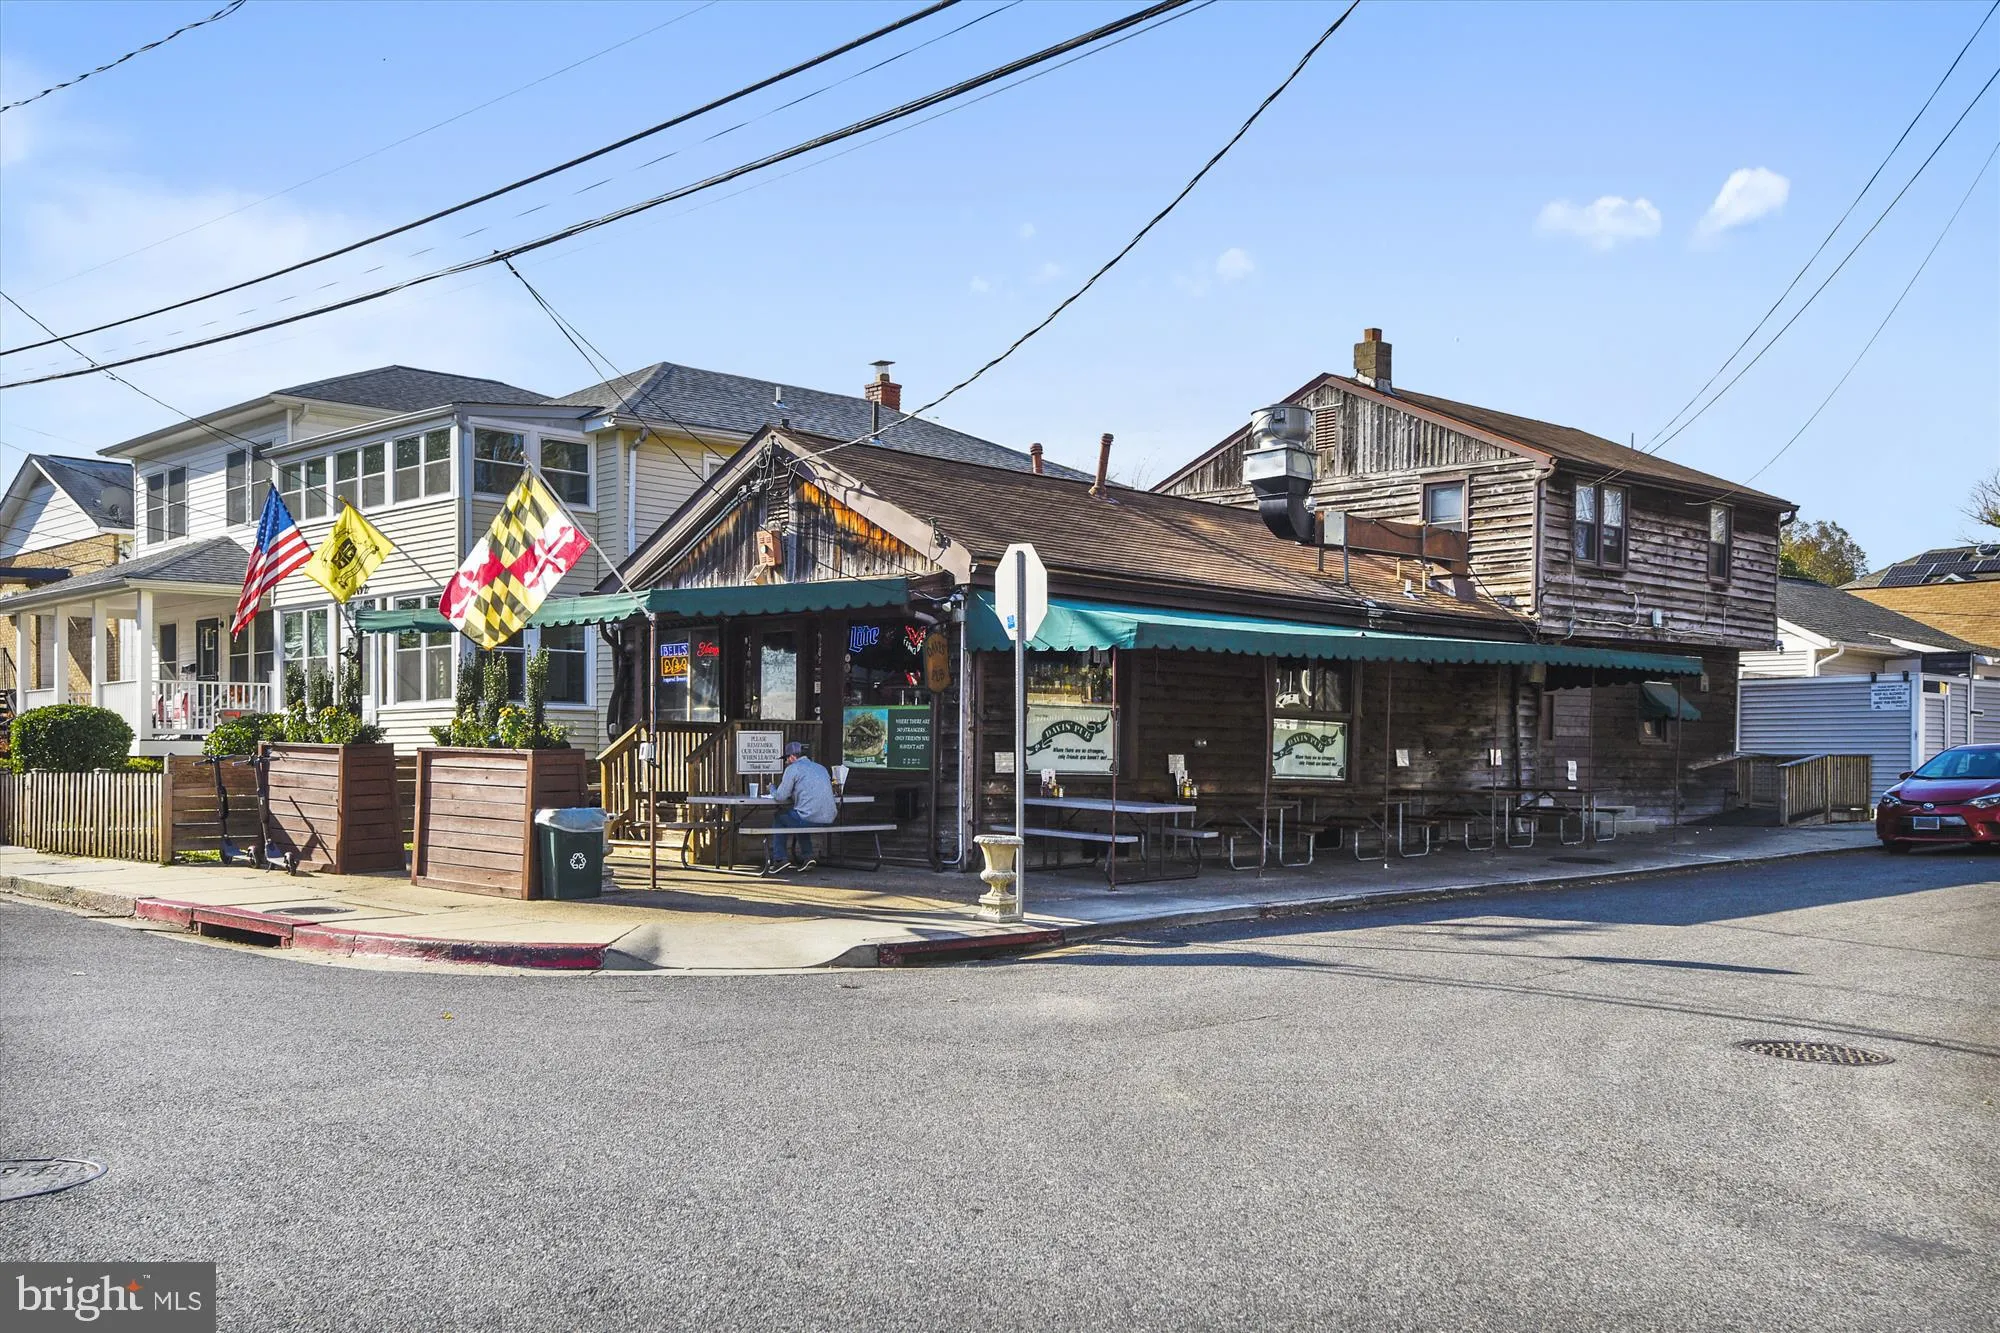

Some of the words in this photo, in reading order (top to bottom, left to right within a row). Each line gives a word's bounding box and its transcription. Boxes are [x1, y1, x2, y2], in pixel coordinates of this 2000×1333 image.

[848, 625, 880, 653] Lite
[1073, 725, 1090, 739] PUB
[1310, 737, 1323, 750] PUB
